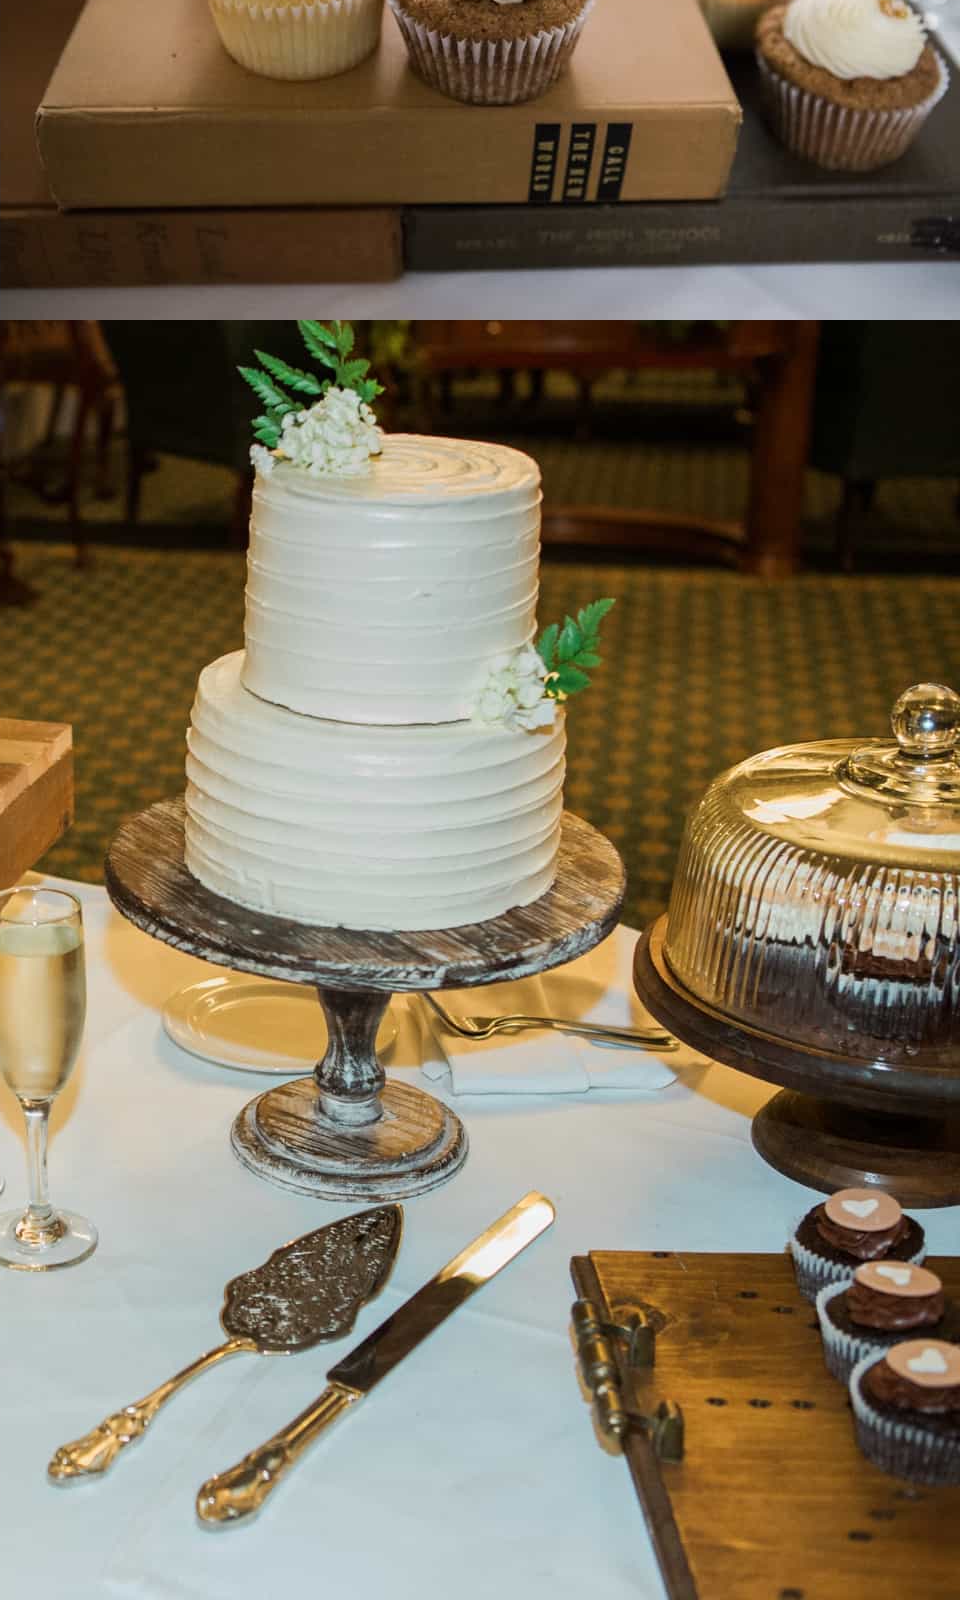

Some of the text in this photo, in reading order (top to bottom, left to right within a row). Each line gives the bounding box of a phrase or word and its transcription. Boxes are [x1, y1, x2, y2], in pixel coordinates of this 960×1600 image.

[533, 140, 555, 192] WORLD
[565, 131, 591, 198] THE NEW
[602, 145, 625, 185] CALL
